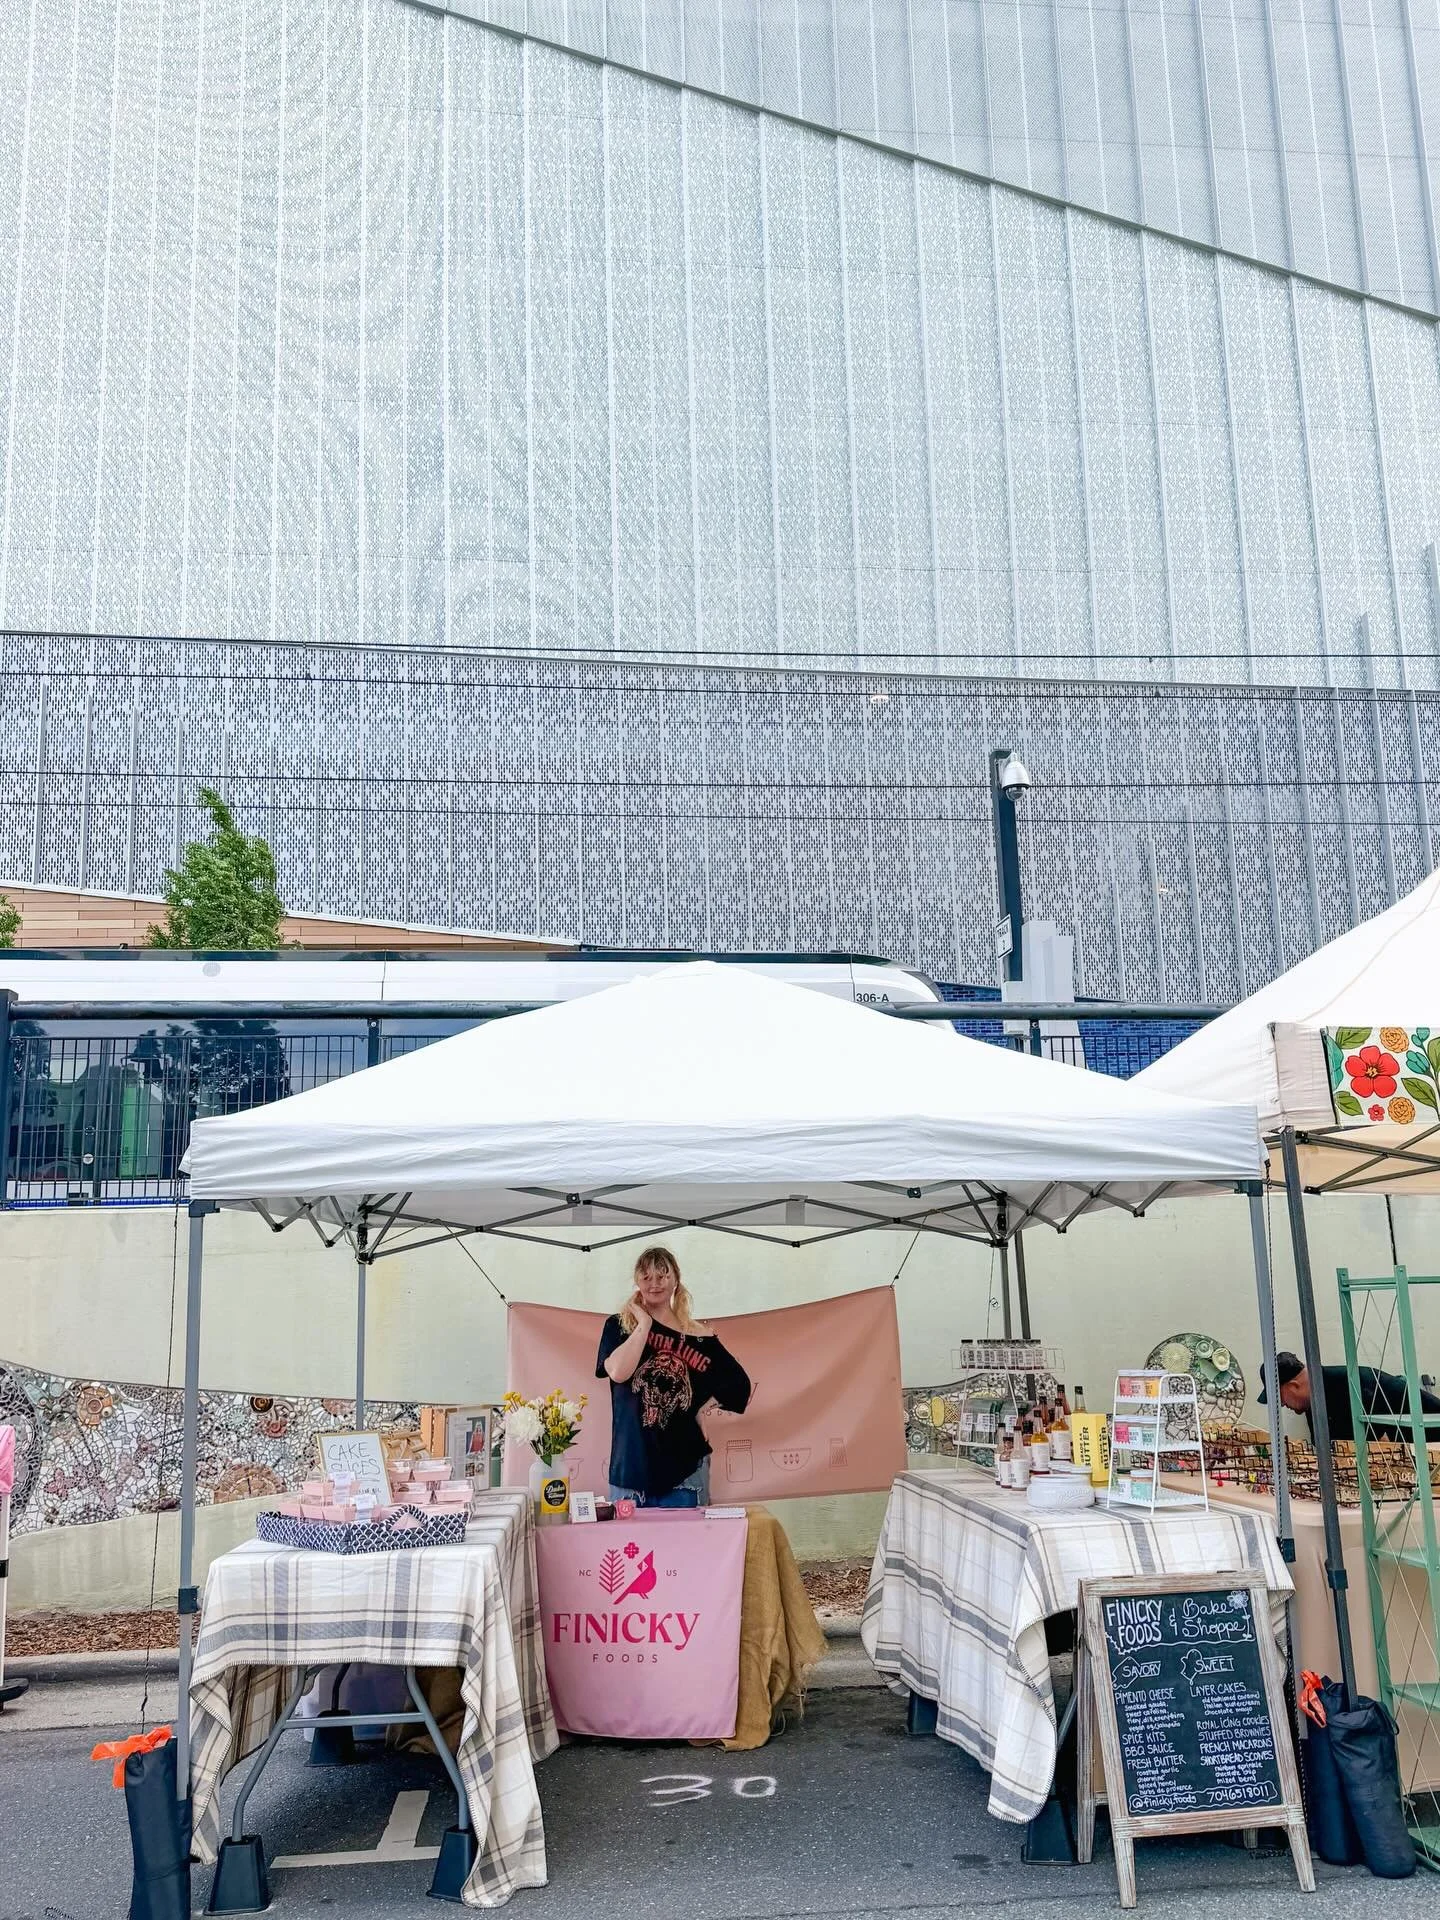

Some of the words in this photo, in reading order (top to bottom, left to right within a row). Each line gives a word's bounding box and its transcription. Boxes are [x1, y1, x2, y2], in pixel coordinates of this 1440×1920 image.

[856, 993, 889, 1002] 306-A
[648, 1331, 674, 1351] RON
[673, 1341, 711, 1372] LUNG
[328, 1441, 371, 1461] CAKE
[1101, 1426, 1109, 1470] BUTTER
[578, 1569, 592, 1577] NC
[666, 1569, 678, 1577] US
[1106, 1599, 1163, 1627] FINICKY
[1181, 1598, 1235, 1620] Bake
[552, 1612, 701, 1651] FINICKY
[1118, 1621, 1162, 1648] FOODS
[1182, 1617, 1246, 1640] Shoppe
[592, 1653, 659, 1664] FOODS
[1194, 1658, 1234, 1674] SWEET
[1122, 1661, 1162, 1677] SAVORY
[1114, 1690, 1147, 1705] PIMENTO
[1149, 1687, 1176, 1701] CHEESE
[1190, 1684, 1217, 1697] LAYER
[1217, 1682, 1246, 1694] CAKES
[1204, 1708, 1234, 1716] chocolate
[1196, 1720, 1220, 1731] ROYAL
[1242, 1714, 1270, 1726] COOKIES
[1122, 1732, 1144, 1745] SPICE
[1146, 1731, 1166, 1743] KITS
[1198, 1730, 1233, 1741] STUFFED
[1234, 1726, 1271, 1739] BROWNIES
[1124, 1745, 1146, 1758] BBQ
[1147, 1742, 1175, 1755] SAUCE
[1200, 1741, 1231, 1754] FRENCH
[1232, 1737, 1273, 1750] MACARONS
[1126, 1757, 1152, 1770] FRESH
[1153, 1754, 1187, 1768] BUTTER
[1200, 1752, 1244, 1766] SHORTBREAD
[1243, 1750, 1274, 1762] SCONES
[639, 1774, 778, 1807] 30
[1206, 1785, 1269, 1803] 7046518011
